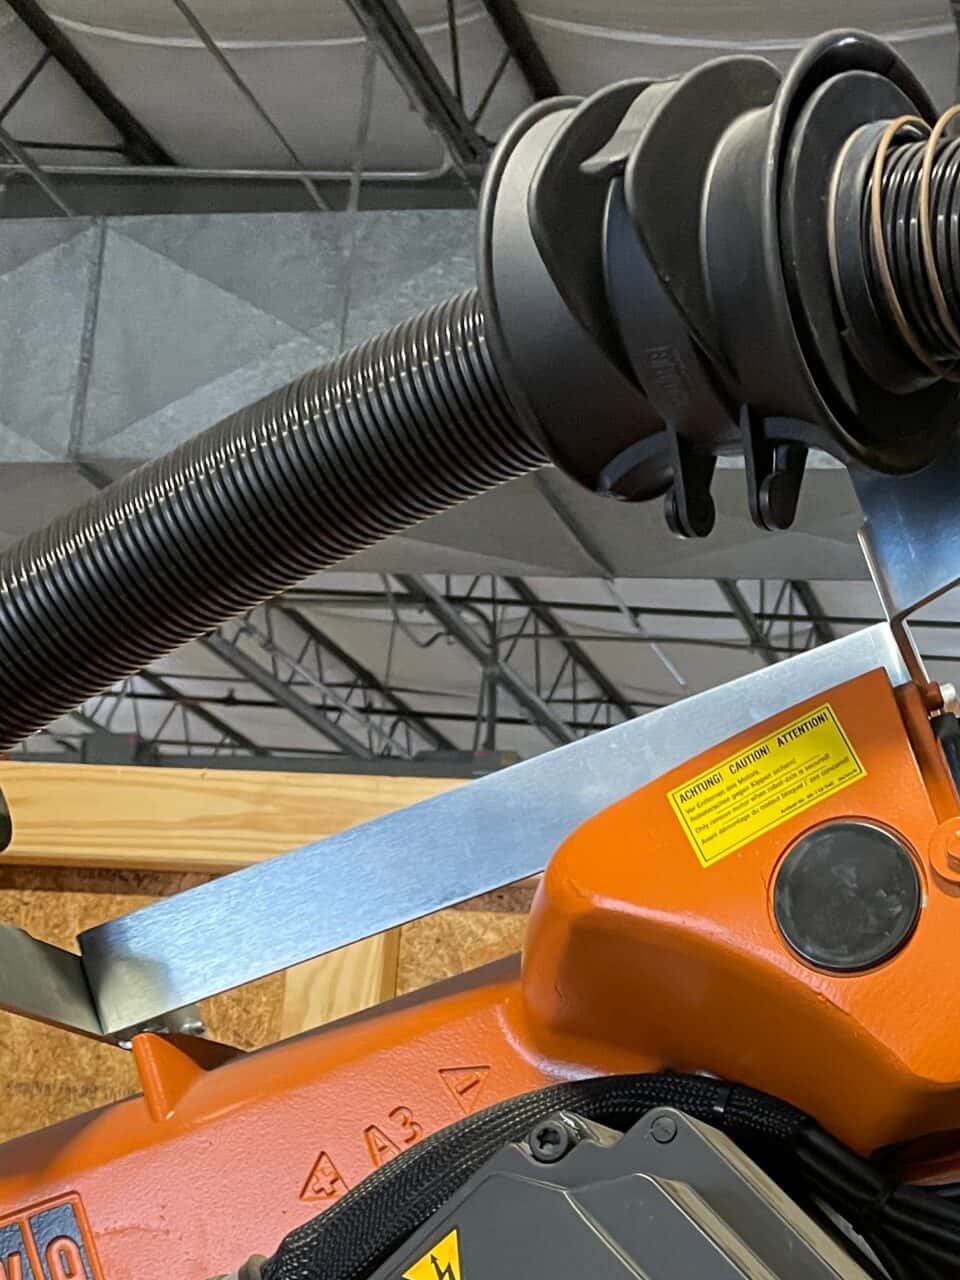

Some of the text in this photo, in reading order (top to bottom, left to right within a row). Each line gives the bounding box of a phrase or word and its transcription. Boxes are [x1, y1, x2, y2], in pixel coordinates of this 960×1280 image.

[679, 712, 828, 803] ACHTUNG! CAUTION! ATTENTION!
[364, 1106, 424, 1168] A3
